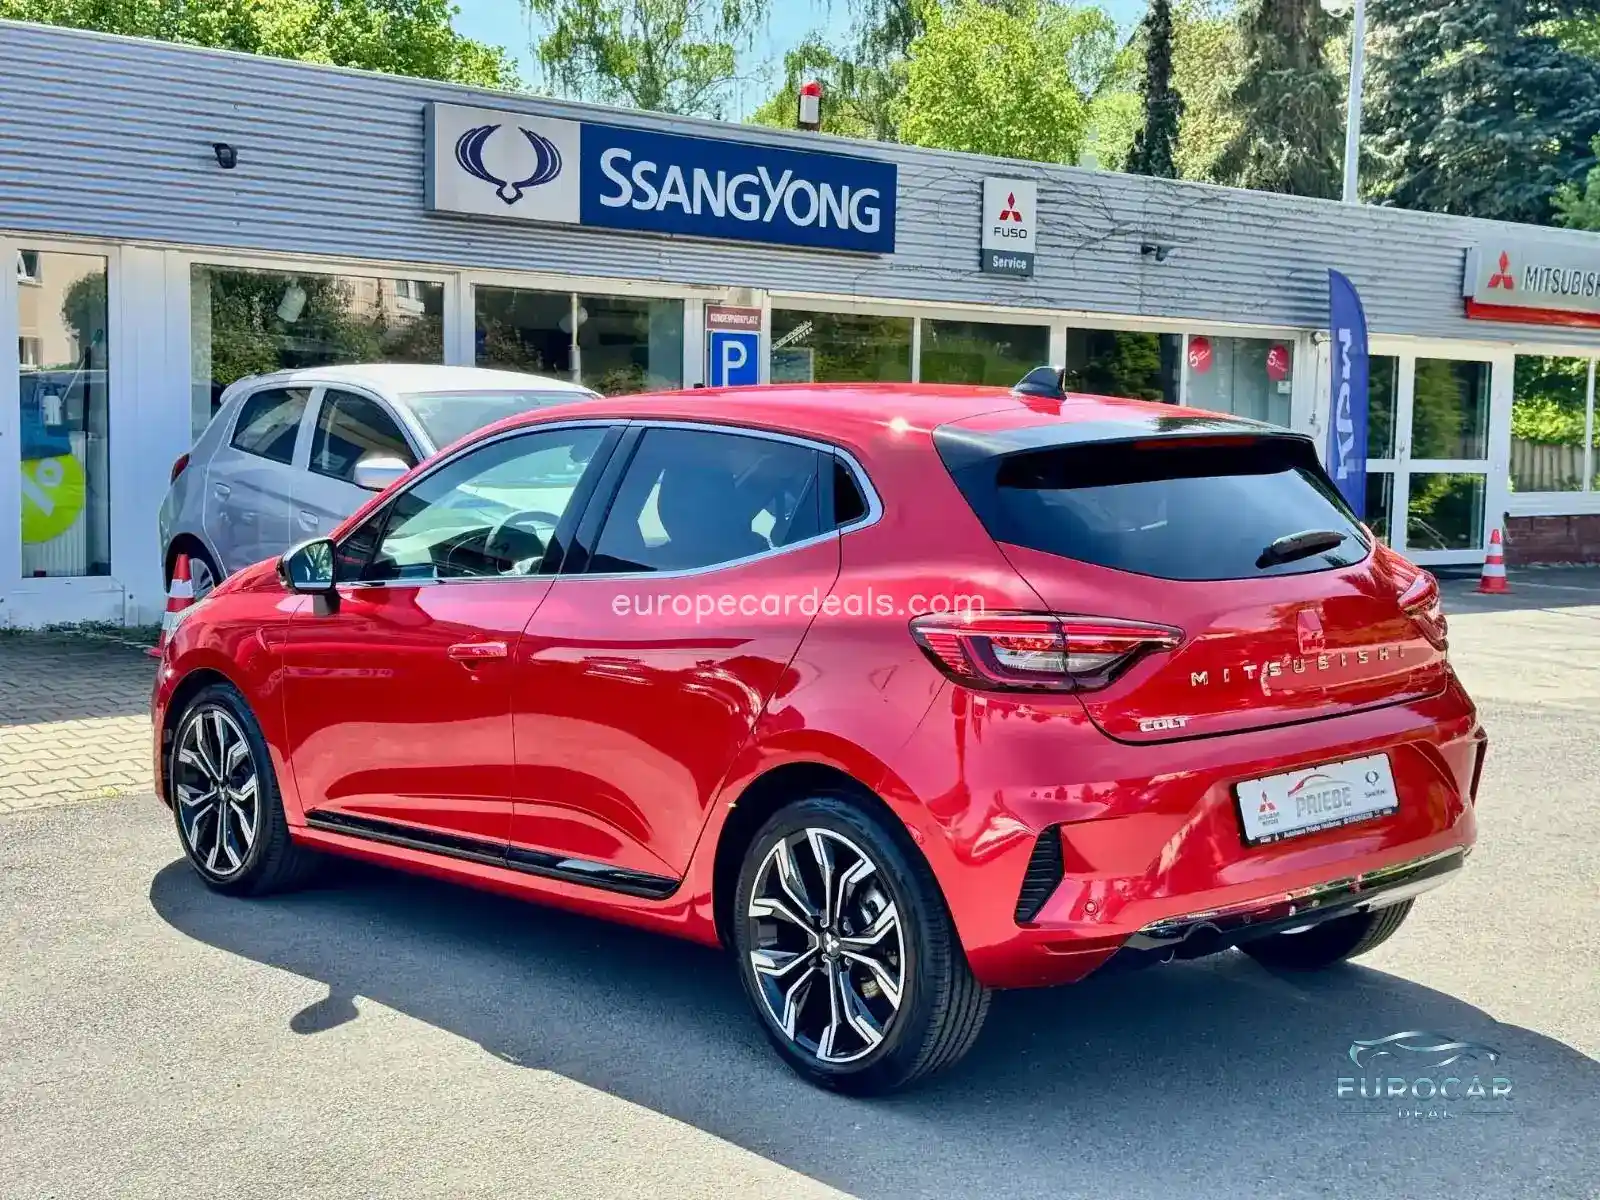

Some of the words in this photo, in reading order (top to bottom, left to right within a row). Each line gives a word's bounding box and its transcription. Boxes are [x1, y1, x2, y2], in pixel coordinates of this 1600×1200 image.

[994, 227, 1027, 239] FUSO
[993, 255, 1027, 269] Service
[722, 340, 747, 387] P
[1191, 645, 1405, 686] MITSUBISHI
[1140, 717, 1186, 732] COLT
[1295, 786, 1352, 817] PRIEBE
